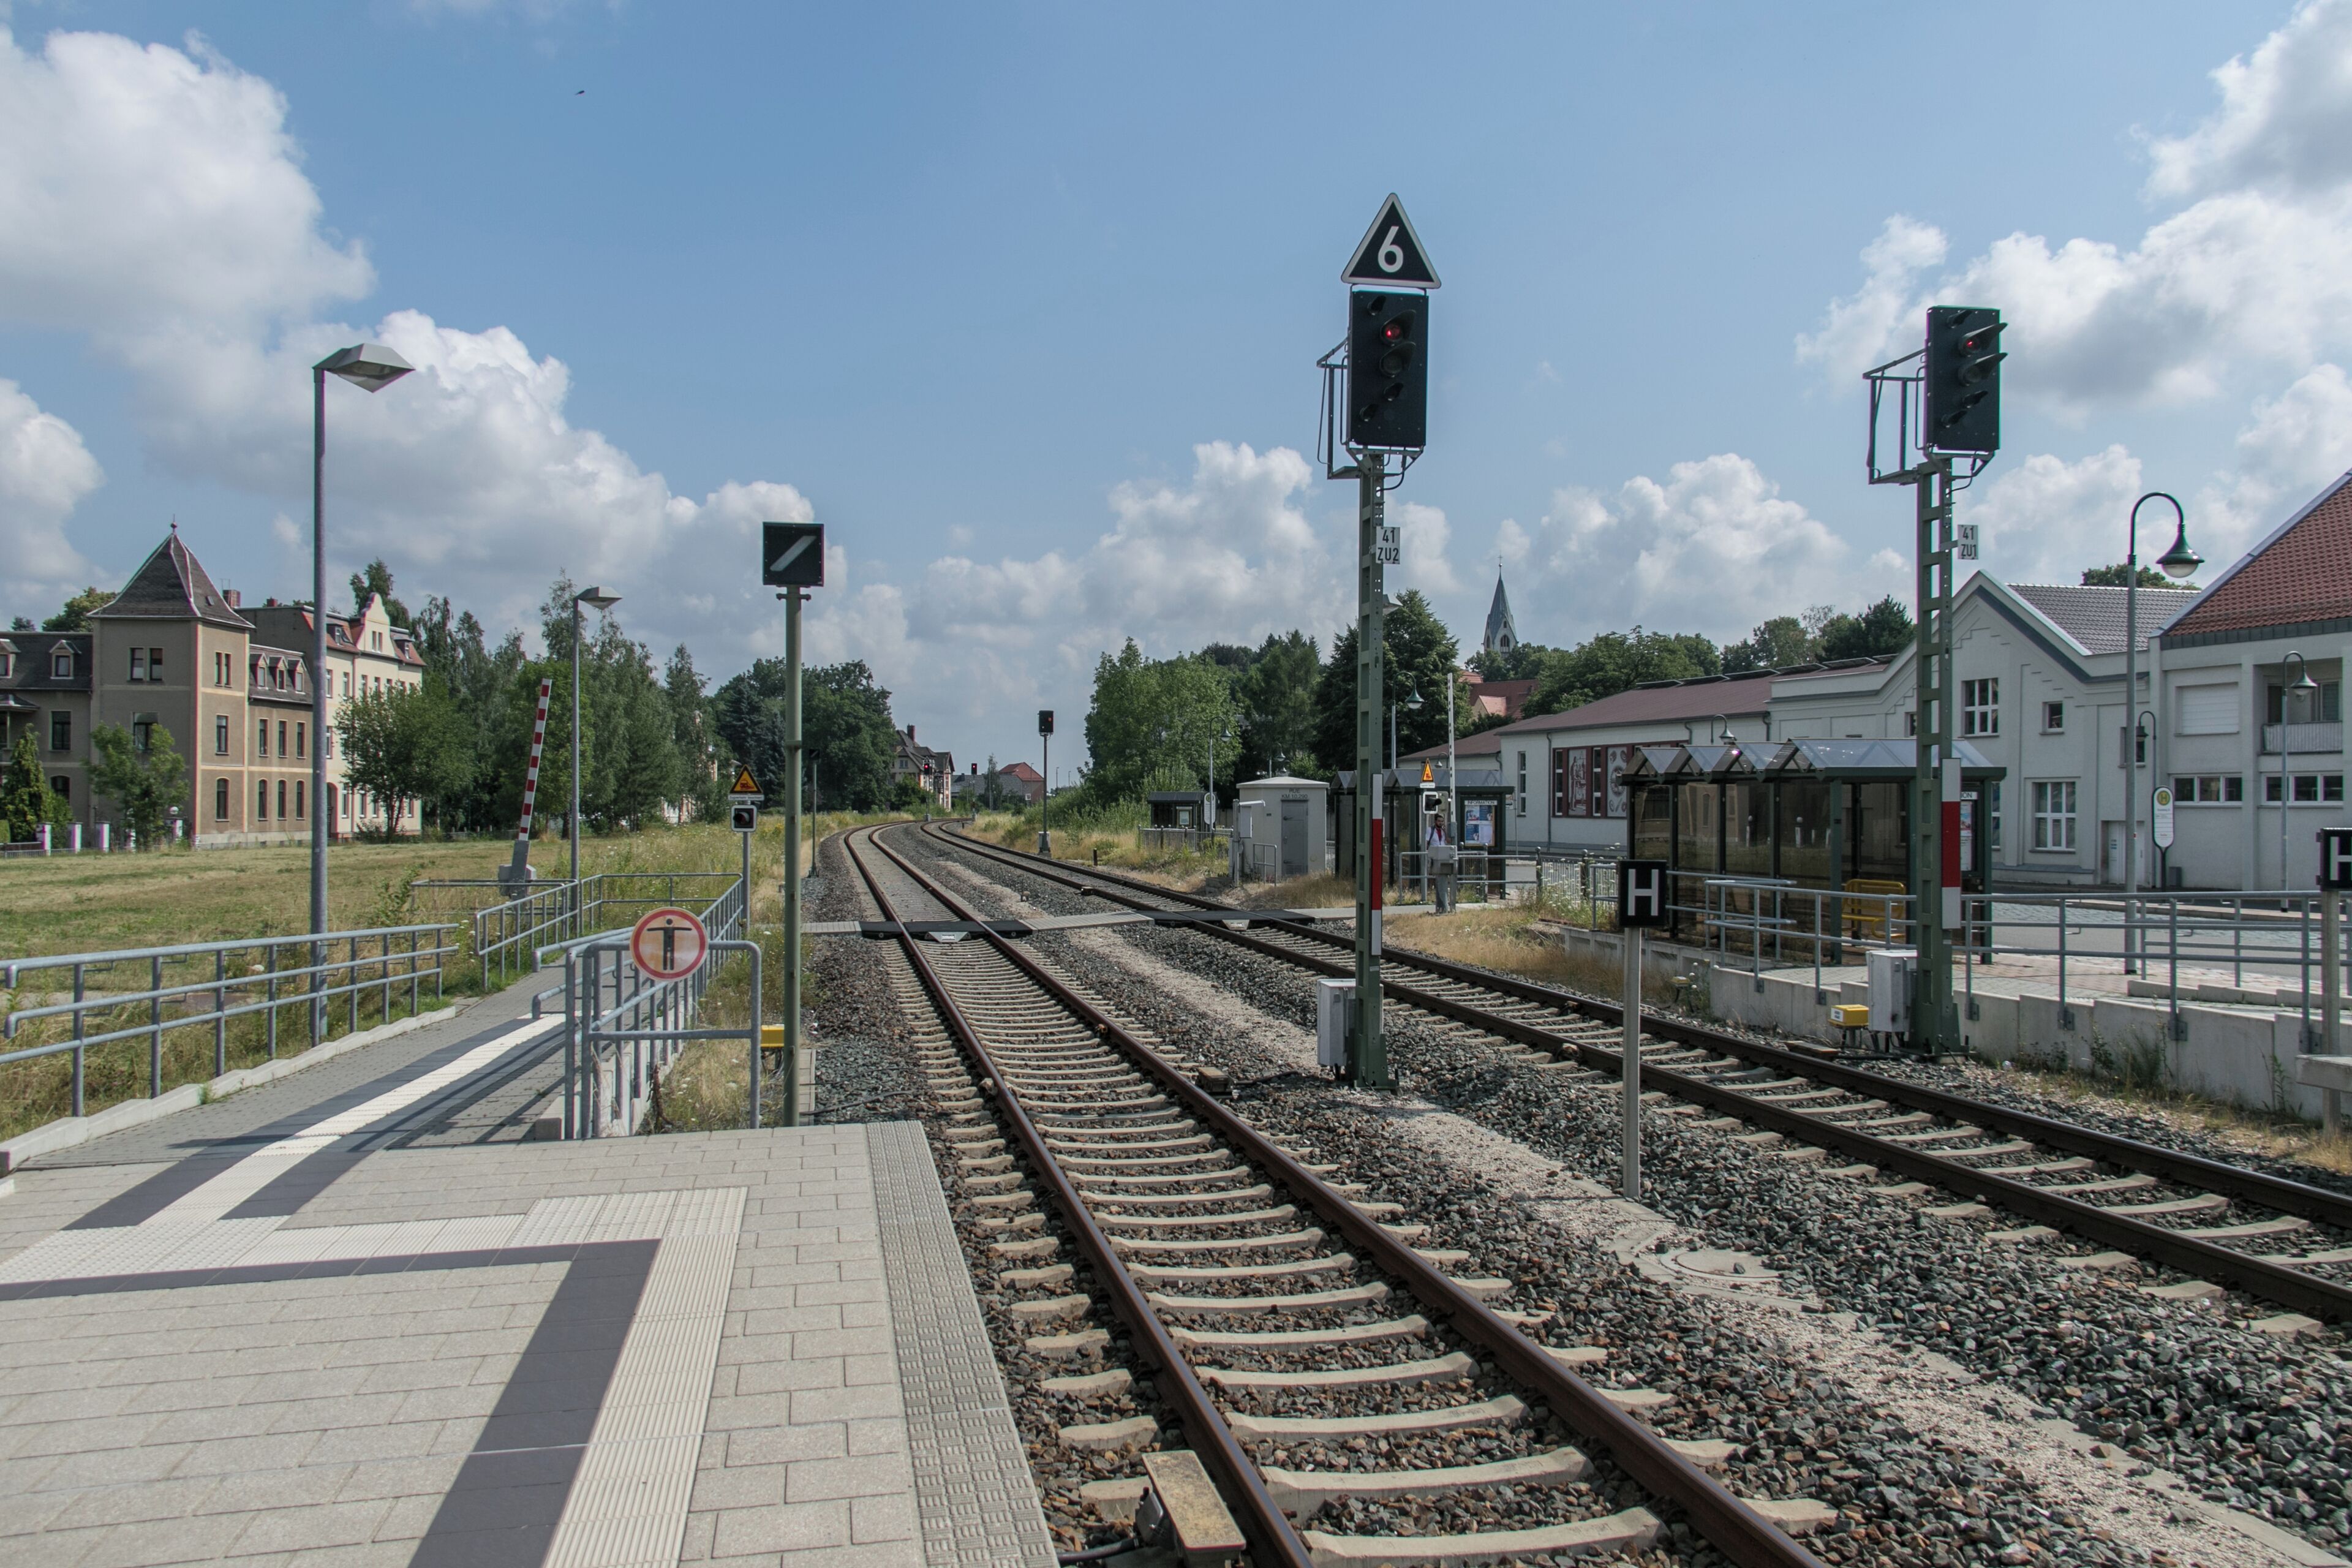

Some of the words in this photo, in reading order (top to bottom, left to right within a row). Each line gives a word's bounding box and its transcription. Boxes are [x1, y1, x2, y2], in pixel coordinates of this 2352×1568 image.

[1378, 225, 1404, 273] 6
[1382, 529, 1395, 543] 41
[1962, 527, 1974, 540] 41
[1378, 547, 1399, 562] ZU2
[1961, 544, 1977, 557] ZU1
[2330, 837, 2352, 881] H
[1627, 869, 1659, 916] H
